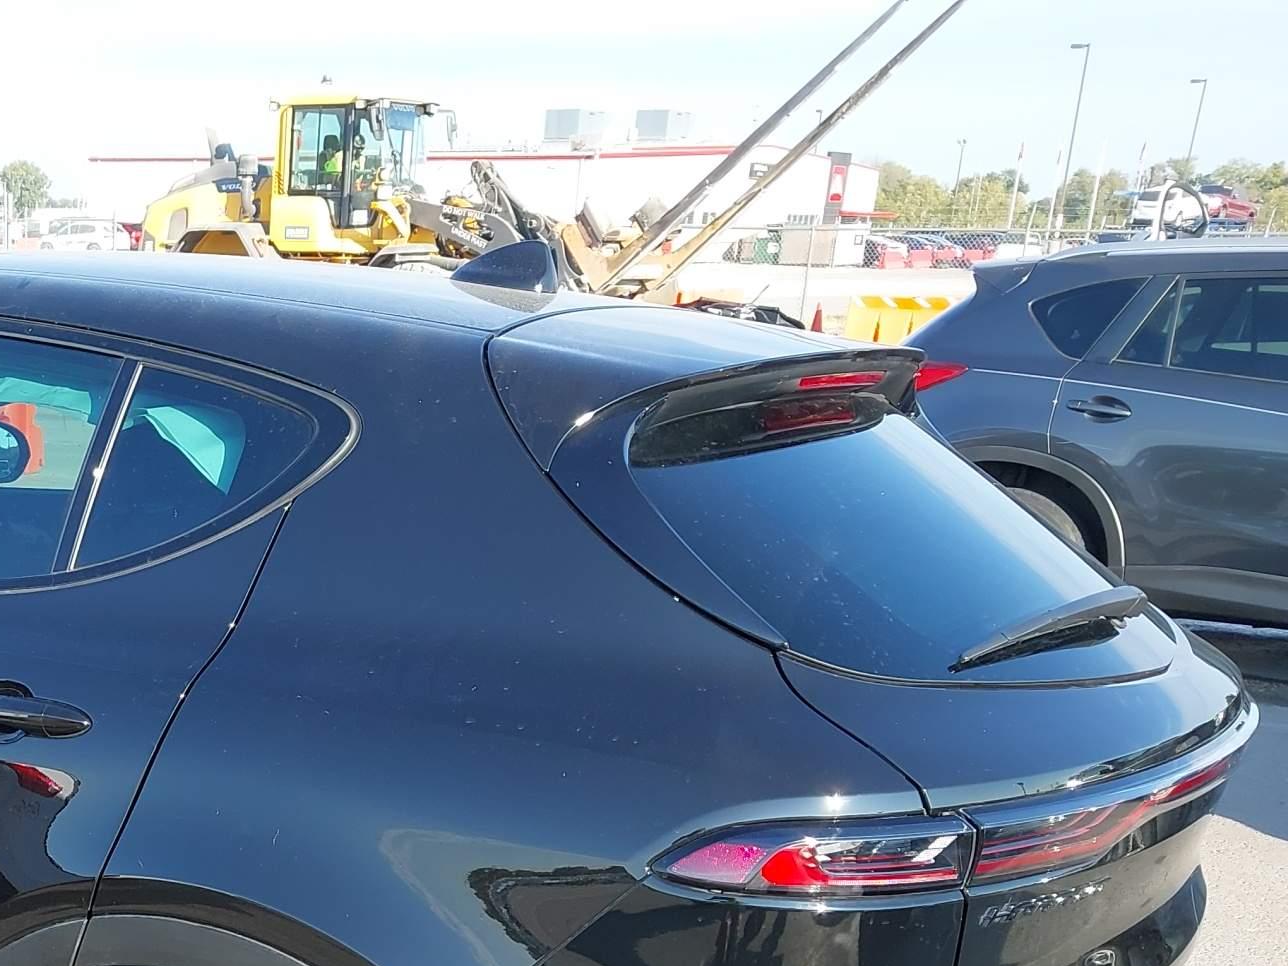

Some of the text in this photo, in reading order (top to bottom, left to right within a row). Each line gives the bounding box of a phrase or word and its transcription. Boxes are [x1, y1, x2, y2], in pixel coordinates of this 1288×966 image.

[442, 205, 485, 220] DO NOT WALK
[451, 226, 488, 248] UNDER MAST
